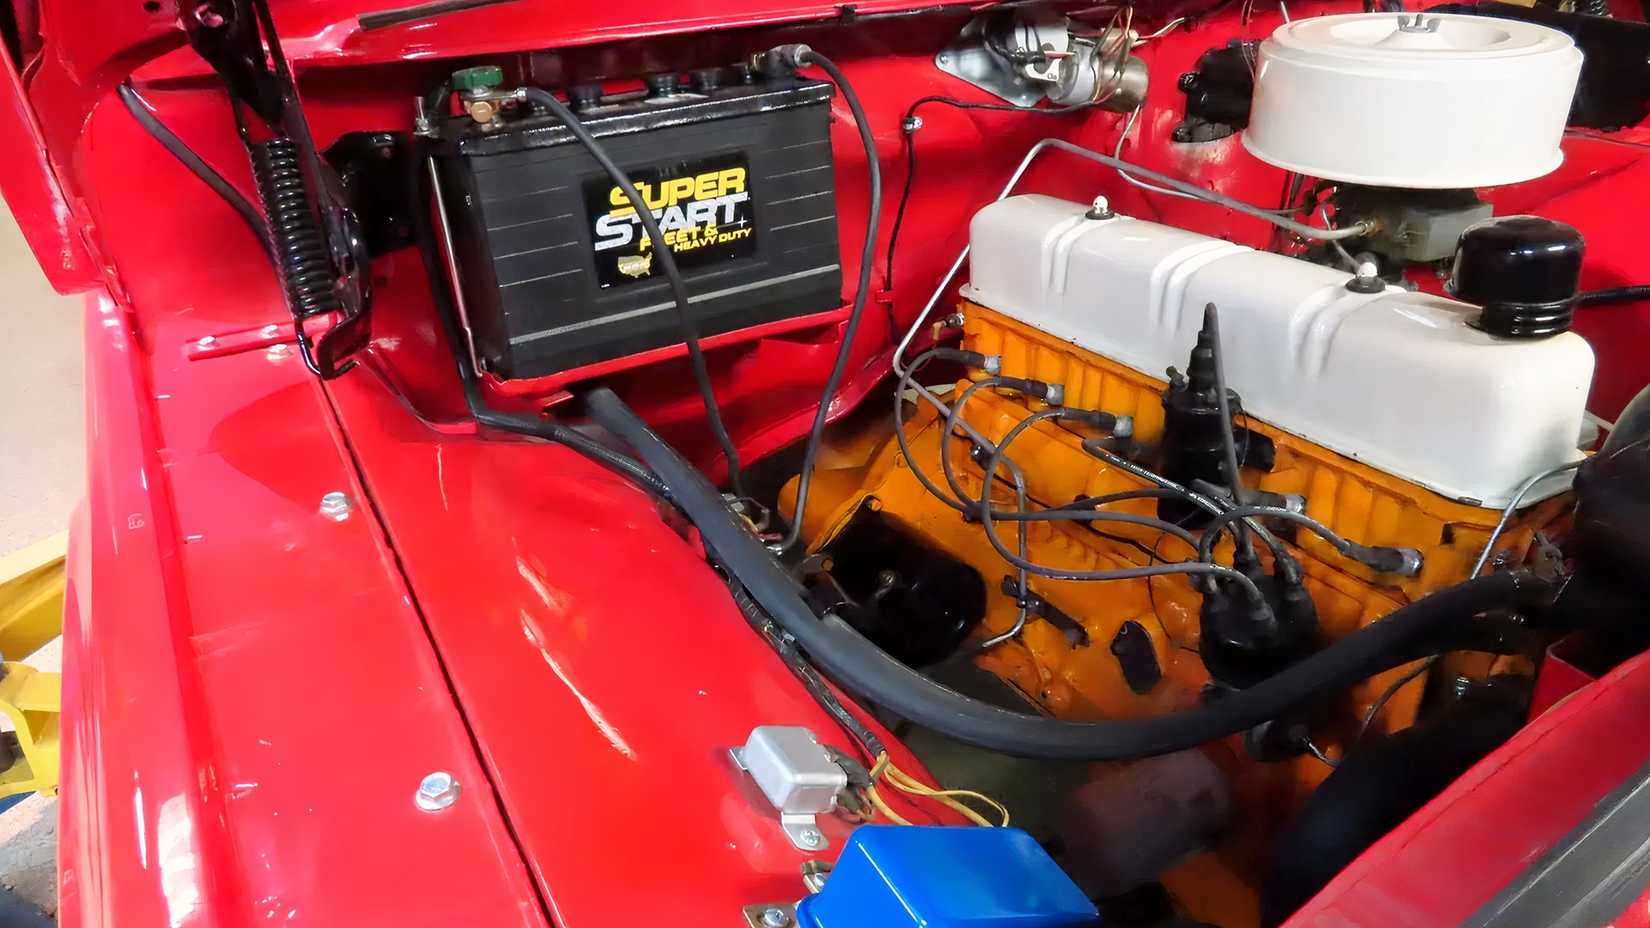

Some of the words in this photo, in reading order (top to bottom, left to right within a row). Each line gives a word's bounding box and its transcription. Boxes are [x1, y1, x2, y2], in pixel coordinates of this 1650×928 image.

[609, 167, 746, 218] SUPER
[595, 191, 748, 251] START
[640, 226, 701, 251] FEET
[704, 223, 719, 238] &
[674, 235, 717, 253] HEAVY
[718, 228, 752, 242] DUTY
